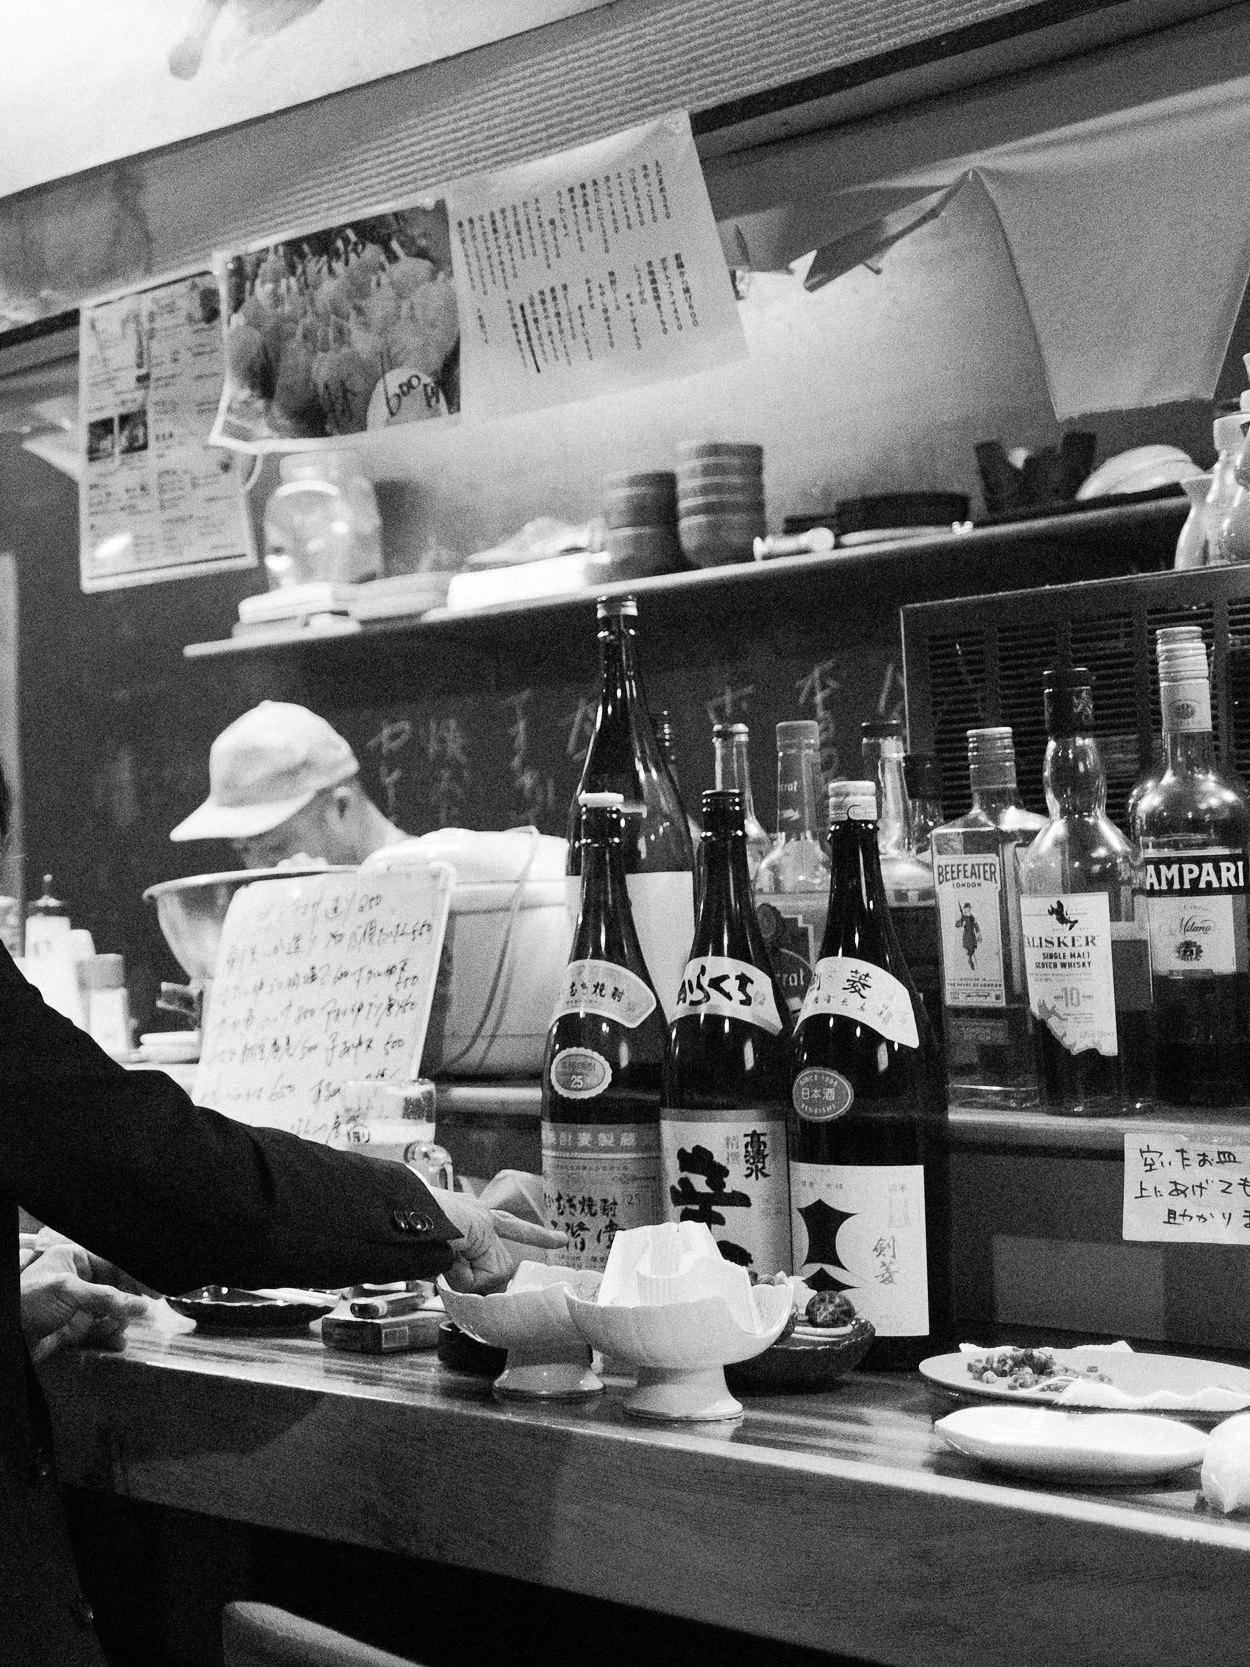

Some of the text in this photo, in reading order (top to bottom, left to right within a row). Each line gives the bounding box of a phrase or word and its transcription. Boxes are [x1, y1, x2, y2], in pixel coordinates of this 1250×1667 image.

[937, 862, 998, 885] BEEFEATER
[1042, 951, 1090, 960] SINGLE MALT
[1035, 961, 1091, 969] SCOTCH WHISKY
[677, 964, 754, 1006] からくち
[1061, 987, 1080, 1009] 10
[570, 1075, 583, 1088] 25
[801, 1088, 835, 1100] 日本酒
[1134, 1177, 1250, 1199] 上にあげても
